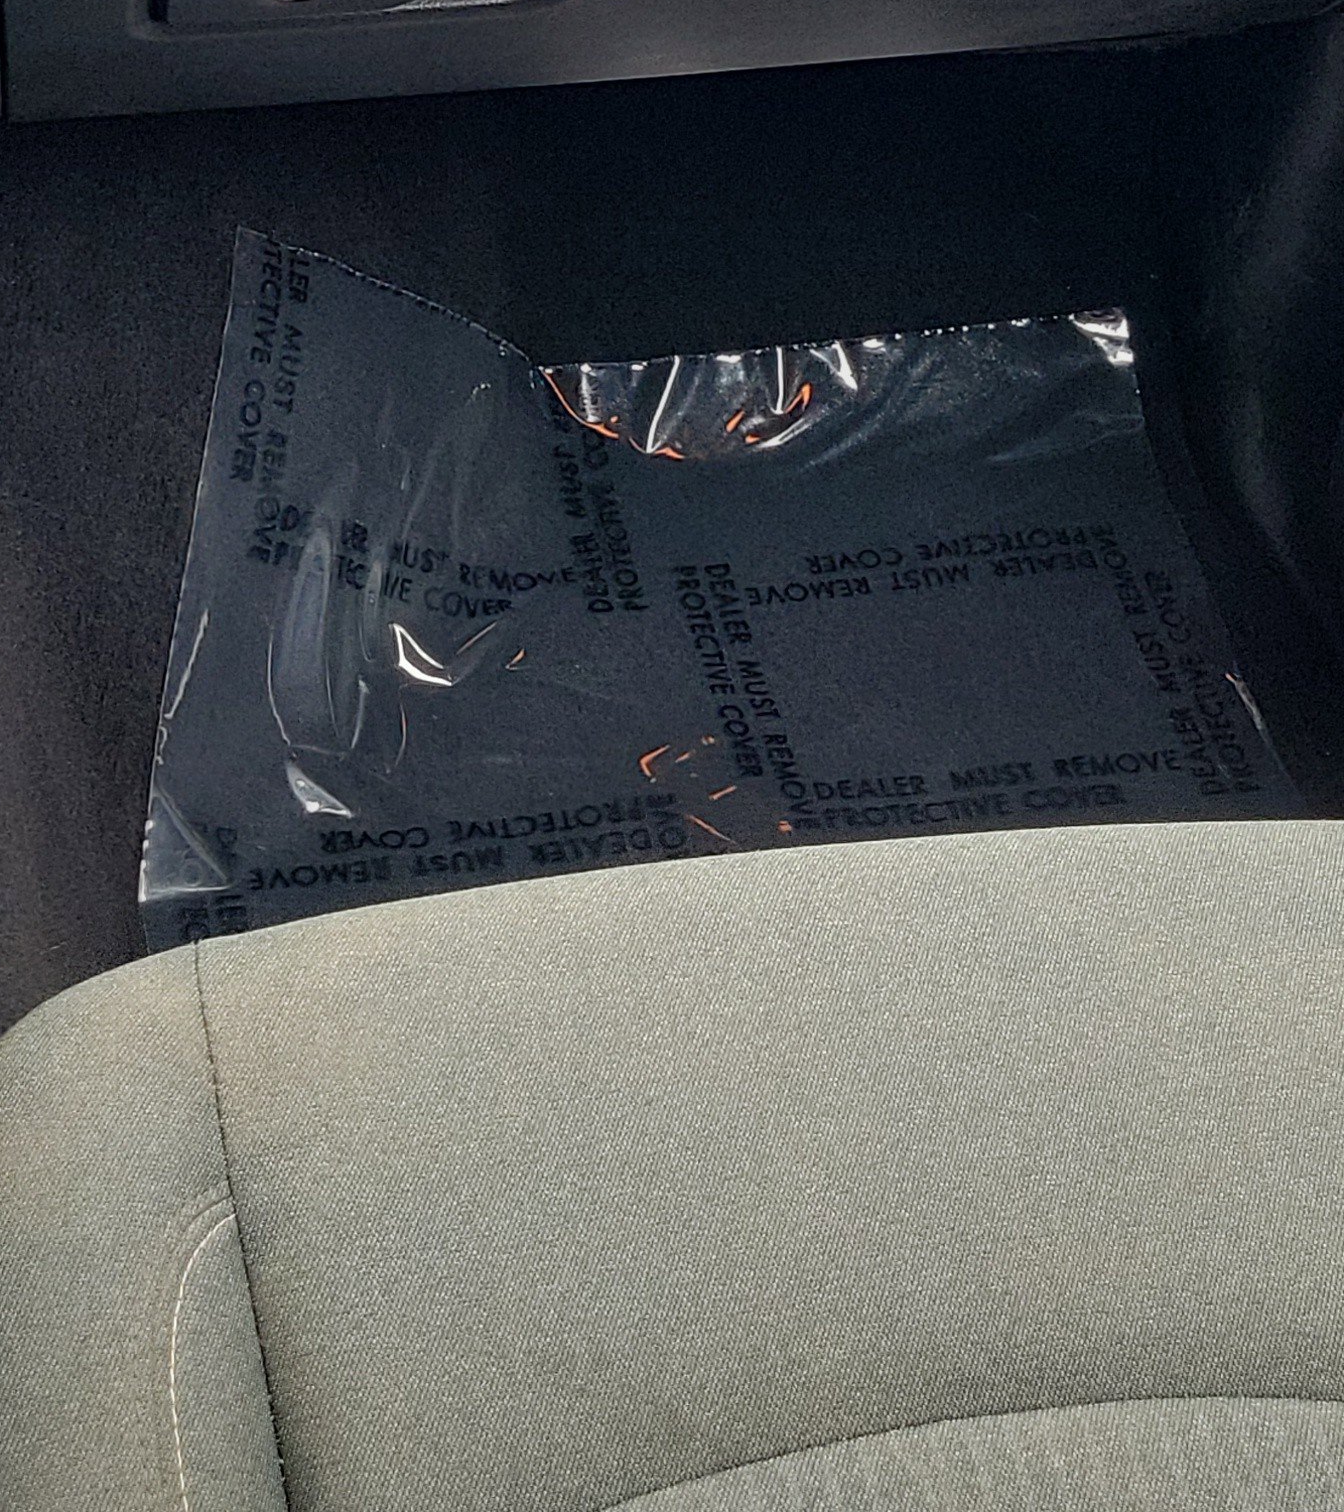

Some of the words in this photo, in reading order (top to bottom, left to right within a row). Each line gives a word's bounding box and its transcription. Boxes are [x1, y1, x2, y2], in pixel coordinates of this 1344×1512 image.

[273, 323, 304, 415] MUST
[228, 378, 268, 483] COVER
[804, 546, 904, 576] COVER
[916, 526, 1088, 561] PROTECTIVE
[457, 561, 578, 593] REMOVE
[890, 563, 971, 593] MUST
[988, 549, 1099, 579] DEALER
[423, 587, 514, 619] COVER
[745, 576, 873, 607] REMOVE
[703, 562, 753, 646] DEALER
[736, 659, 781, 720] MUST
[674, 564, 737, 696] PROTECTIVE
[717, 703, 765, 779] COVER
[1132, 628, 1182, 694] MUST
[812, 775, 927, 801] DEALER
[948, 761, 1034, 791] MUST
[1052, 748, 1184, 778] REMOVE
[447, 797, 644, 842] PROTECTIVE
[319, 826, 431, 855] COVER
[528, 828, 653, 867] DEALER
[248, 854, 392, 891] REMOVE
[410, 845, 505, 877] MUST
